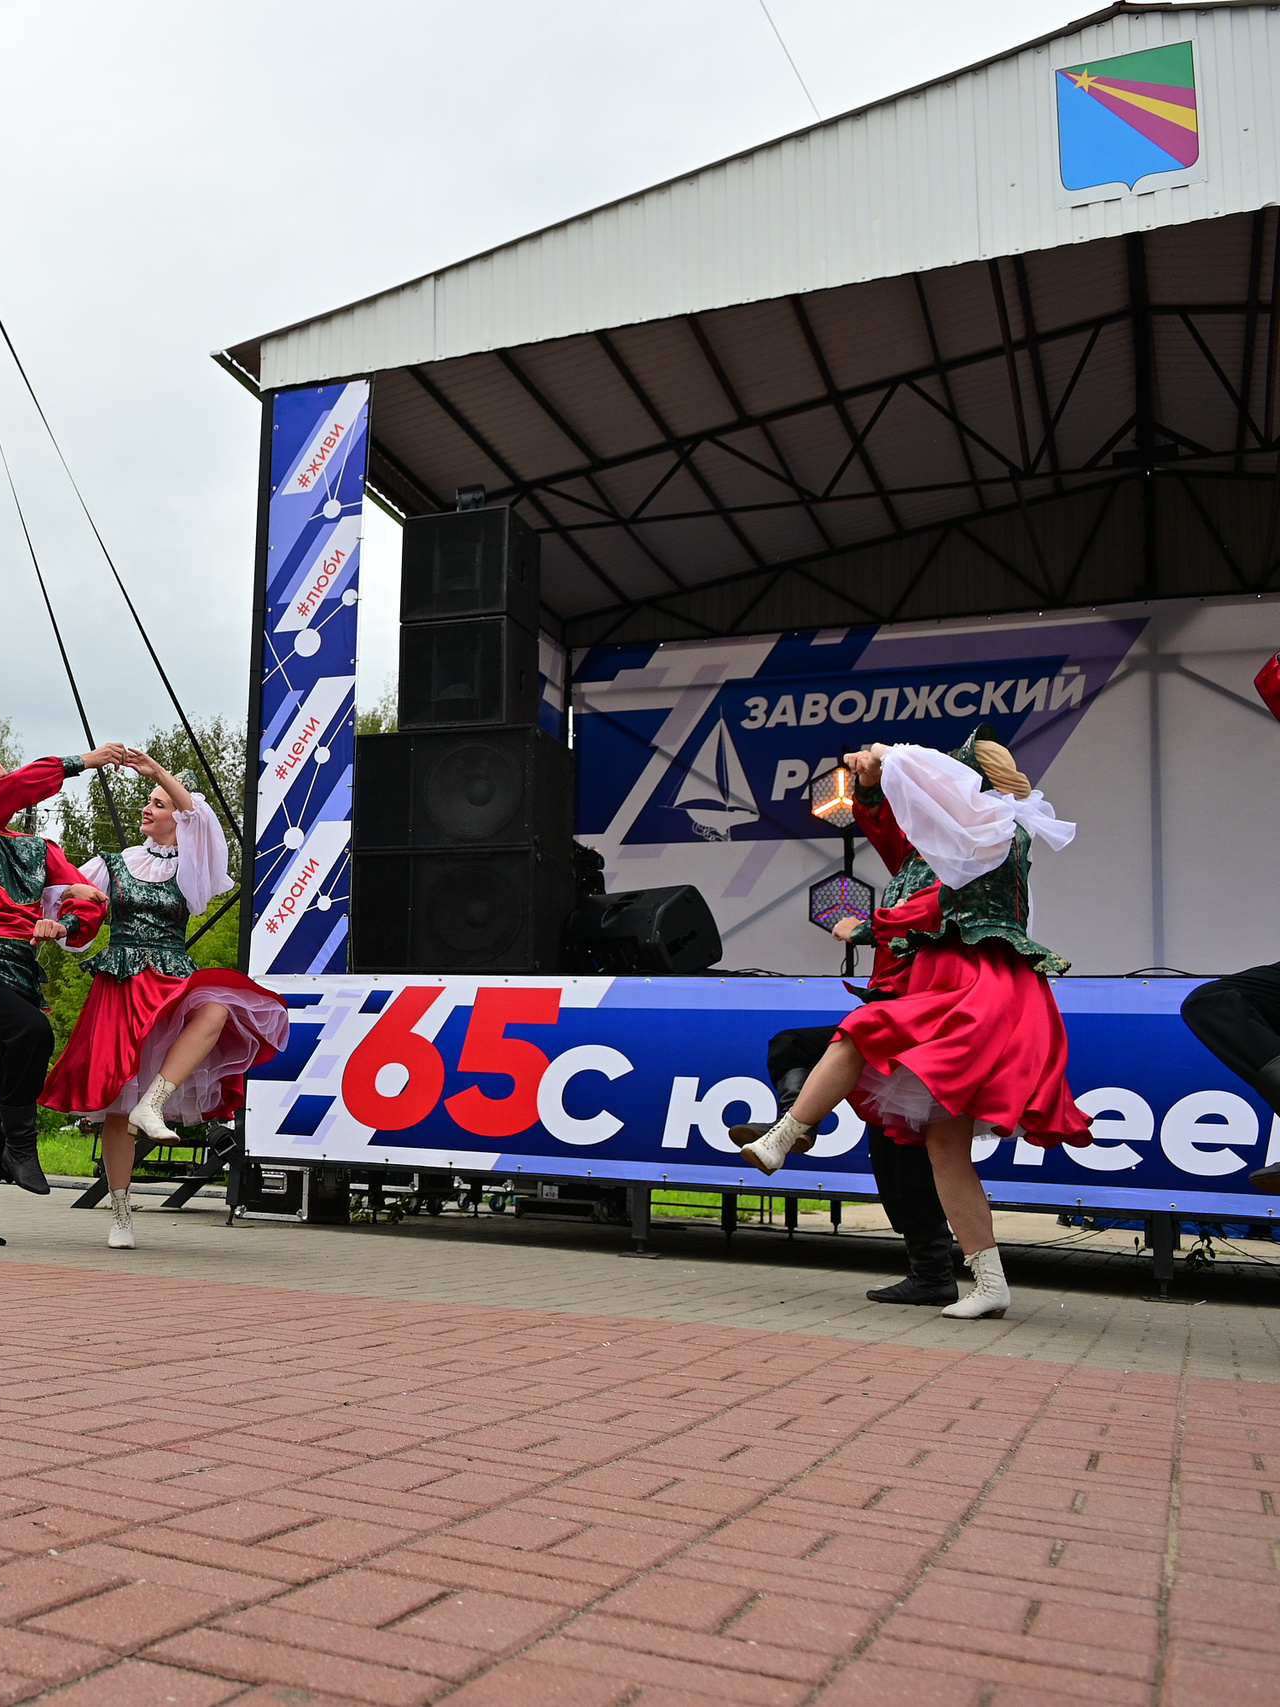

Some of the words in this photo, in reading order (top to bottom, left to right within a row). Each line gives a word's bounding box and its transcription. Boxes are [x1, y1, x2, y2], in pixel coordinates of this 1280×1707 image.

[297, 423, 345, 488] #живи
[296, 549, 346, 617] #люби
[740, 666, 1087, 730] ЗАВОЛЖСКИЙ
[274, 716, 321, 780] #цени
[265, 857, 320, 934] #храни
[341, 985, 563, 1137] 65
